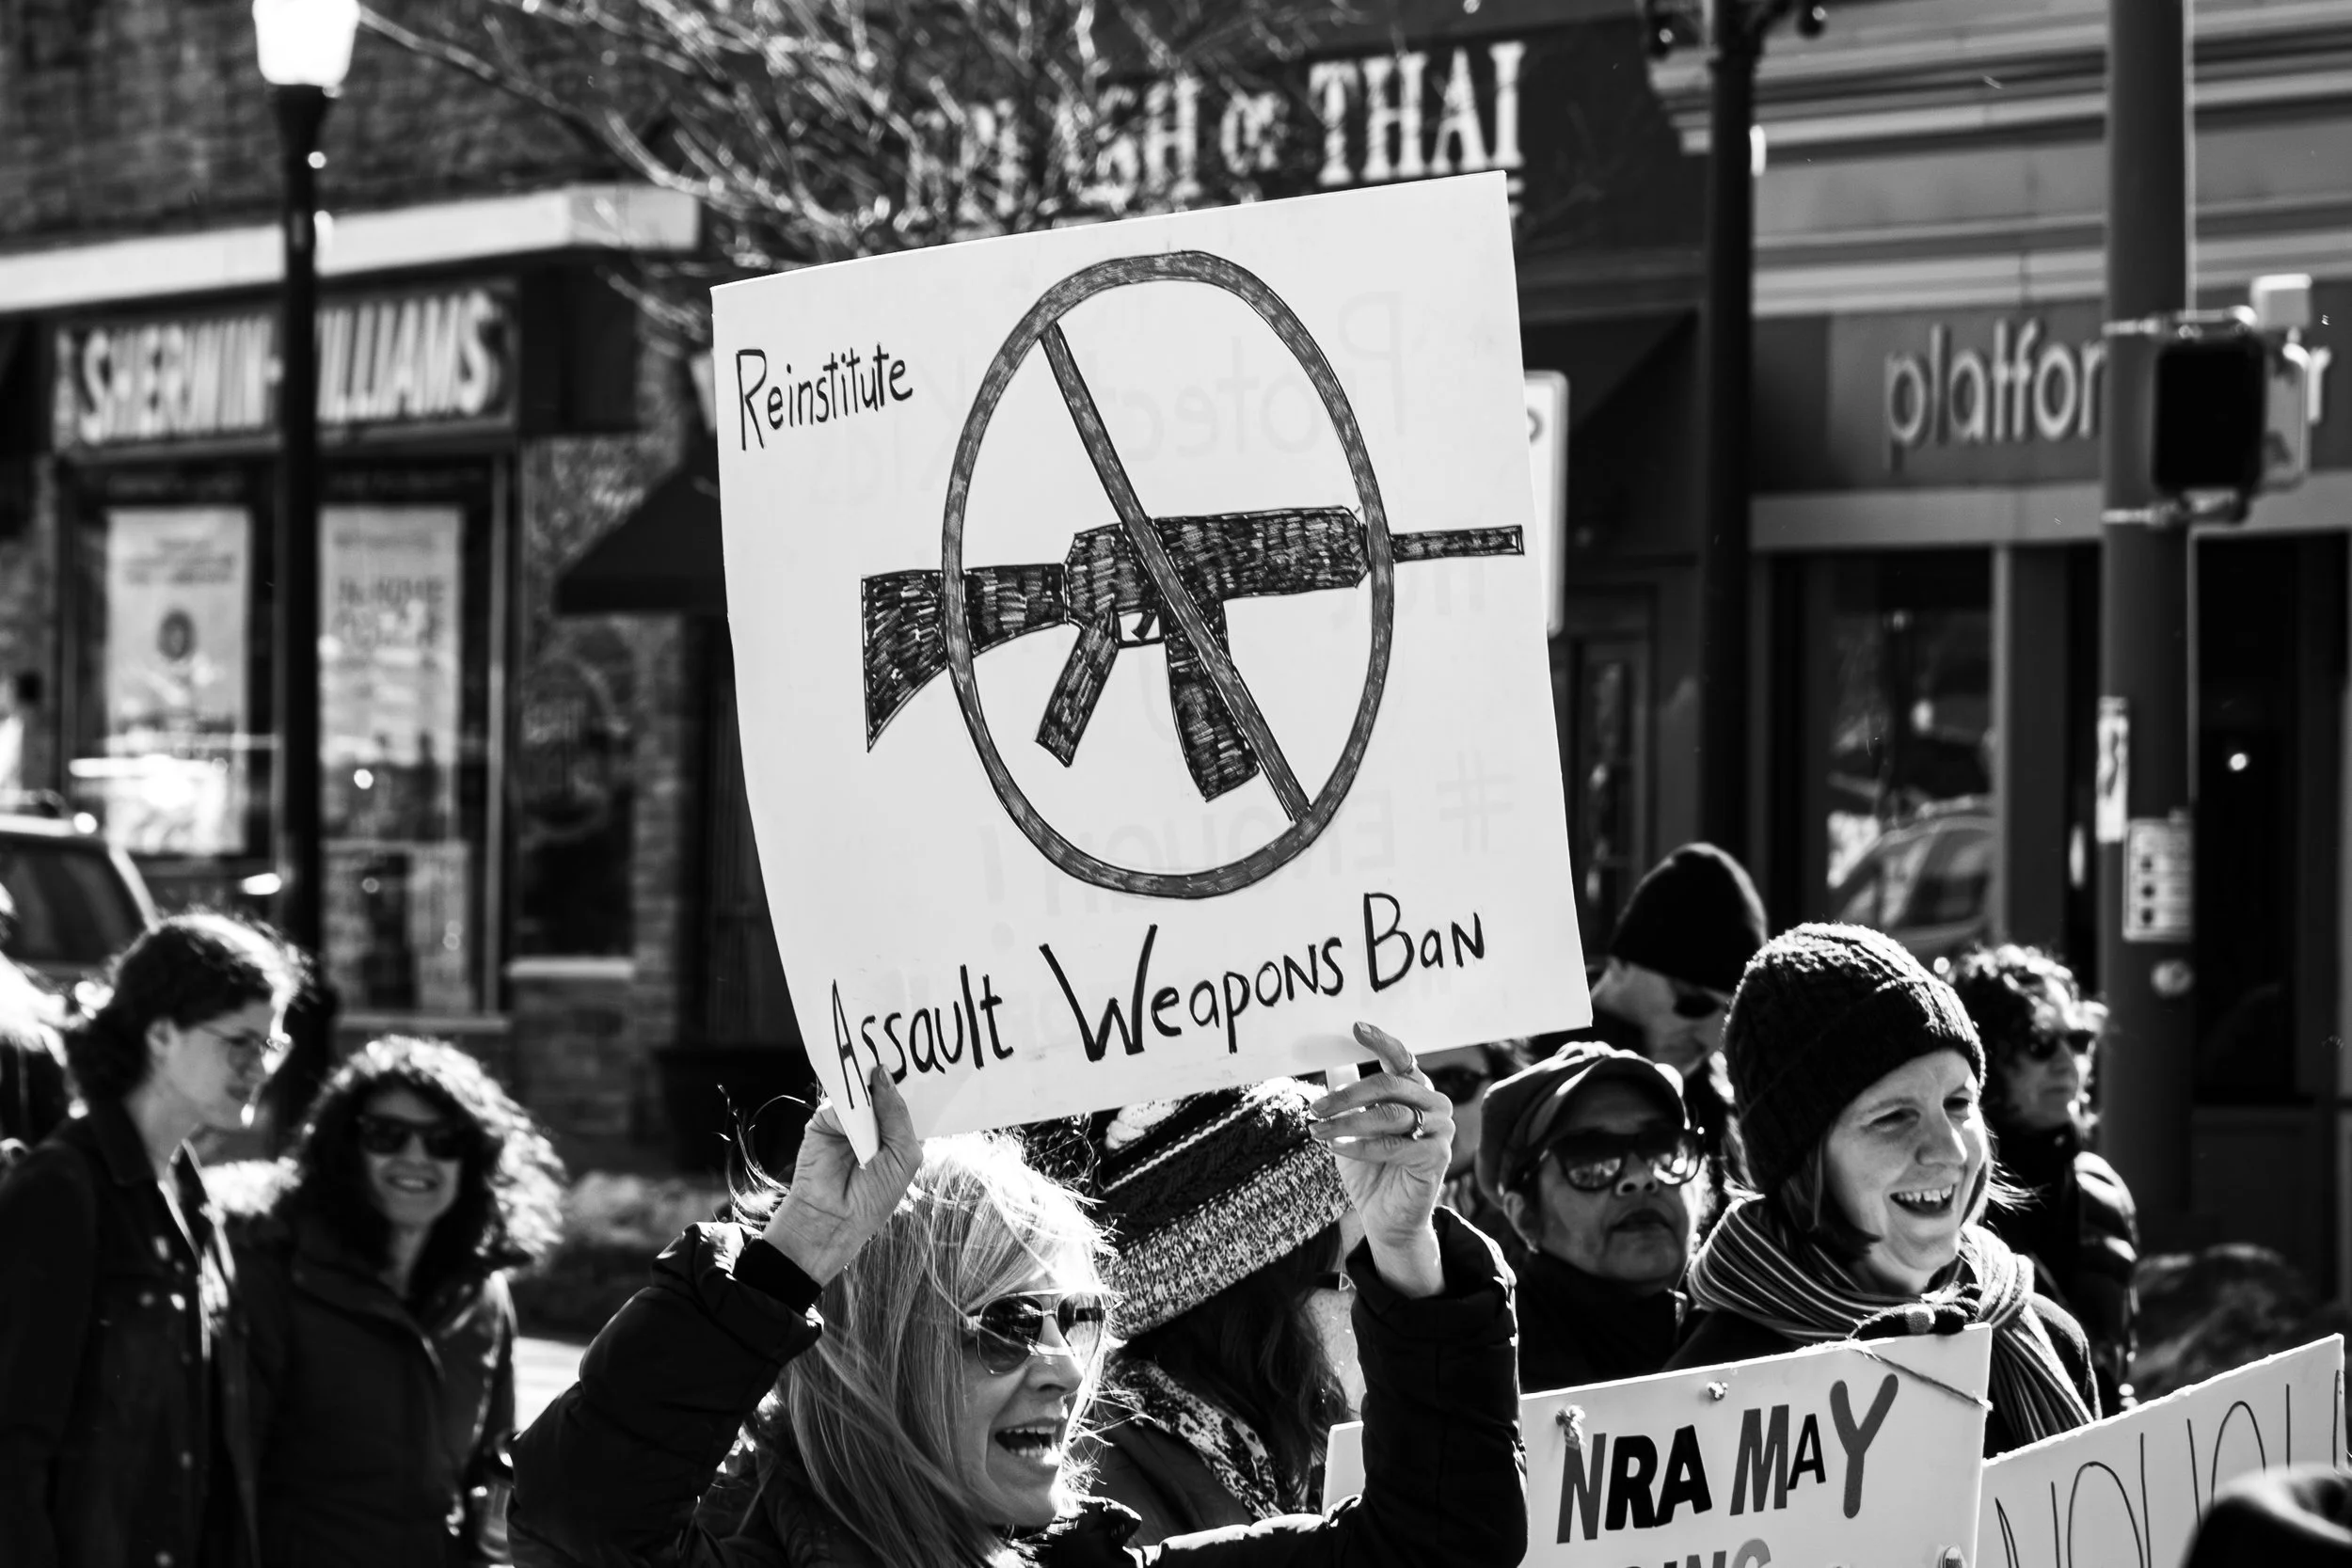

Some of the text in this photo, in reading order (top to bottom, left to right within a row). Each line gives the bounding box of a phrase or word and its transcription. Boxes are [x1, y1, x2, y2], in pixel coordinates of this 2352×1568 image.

[1309, 41, 1525, 186] THAI
[736, 343, 914, 451] Reinstitute
[1885, 317, 2106, 473] platfor
[833, 893, 1485, 1110] Assault Weapons Ban
[1555, 1373, 1899, 1544] NRA MAY
